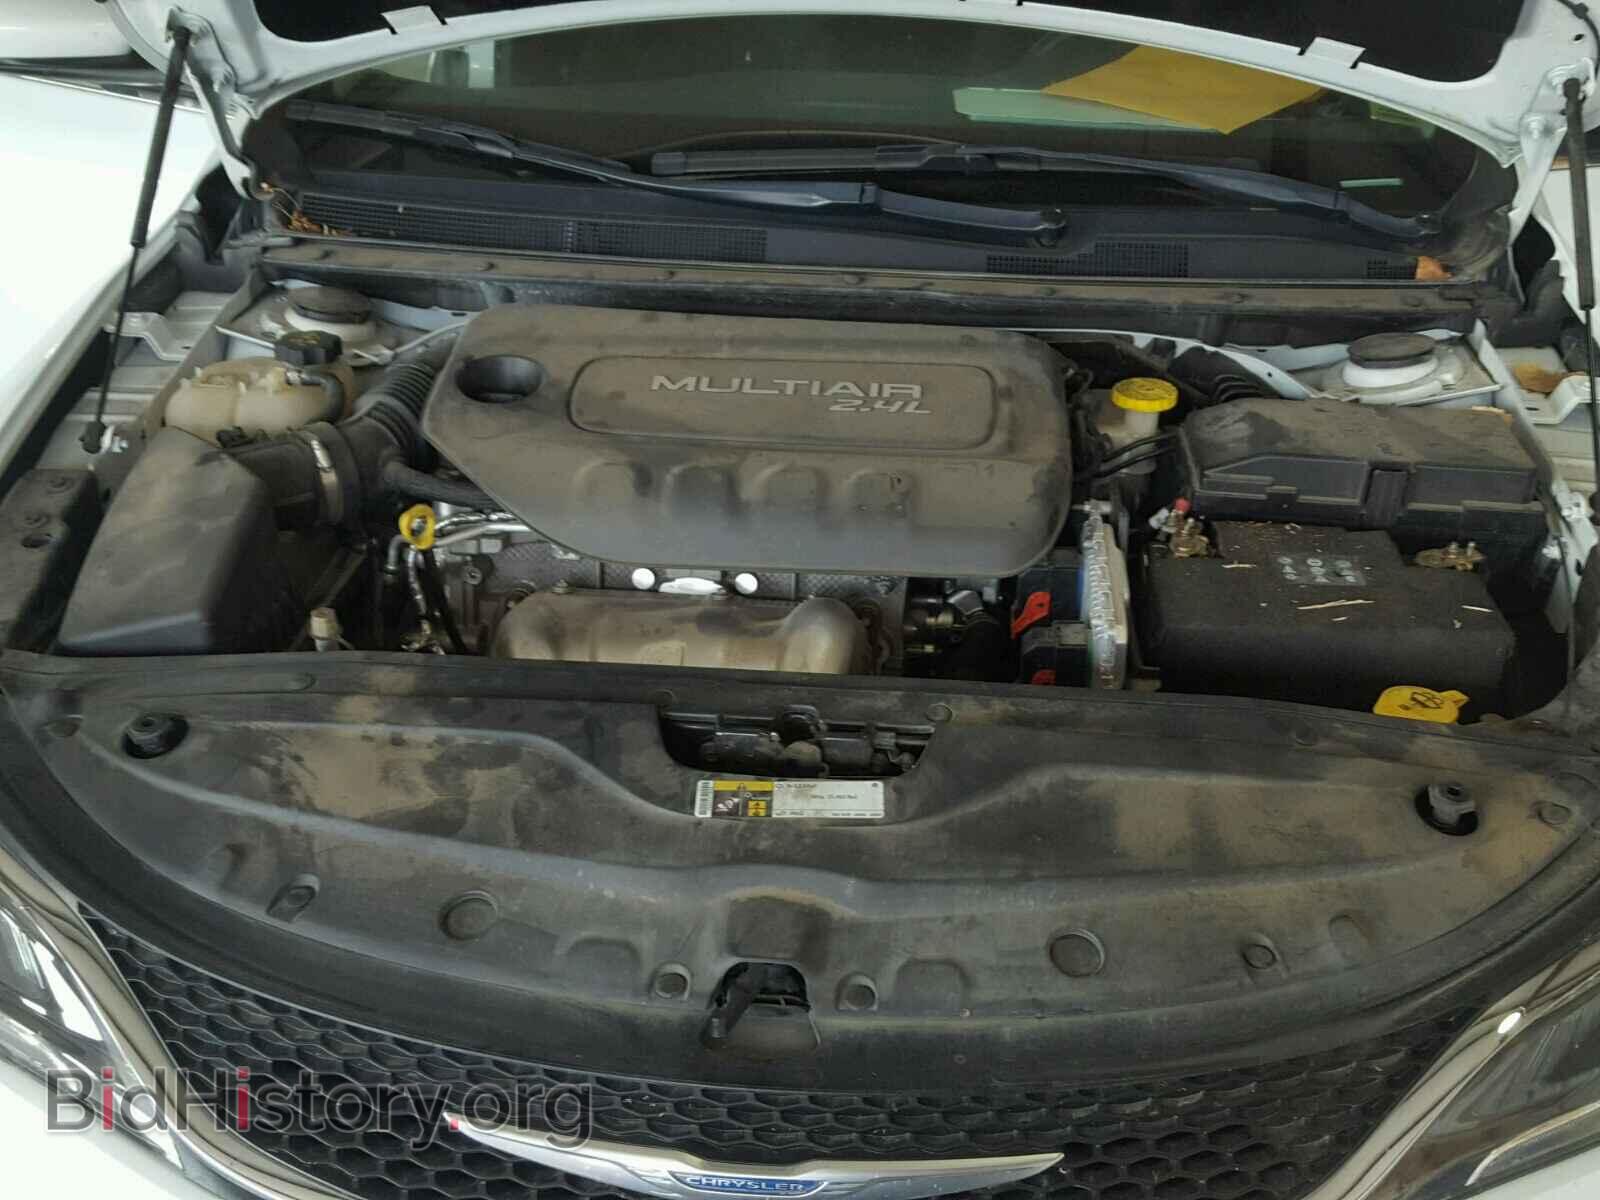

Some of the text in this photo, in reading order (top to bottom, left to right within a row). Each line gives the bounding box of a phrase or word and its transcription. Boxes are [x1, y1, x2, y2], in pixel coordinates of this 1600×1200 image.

[651, 375, 922, 398] MULTIAIR
[830, 399, 931, 414] 2.4L
[686, 1176, 804, 1192] CHRYSLER
